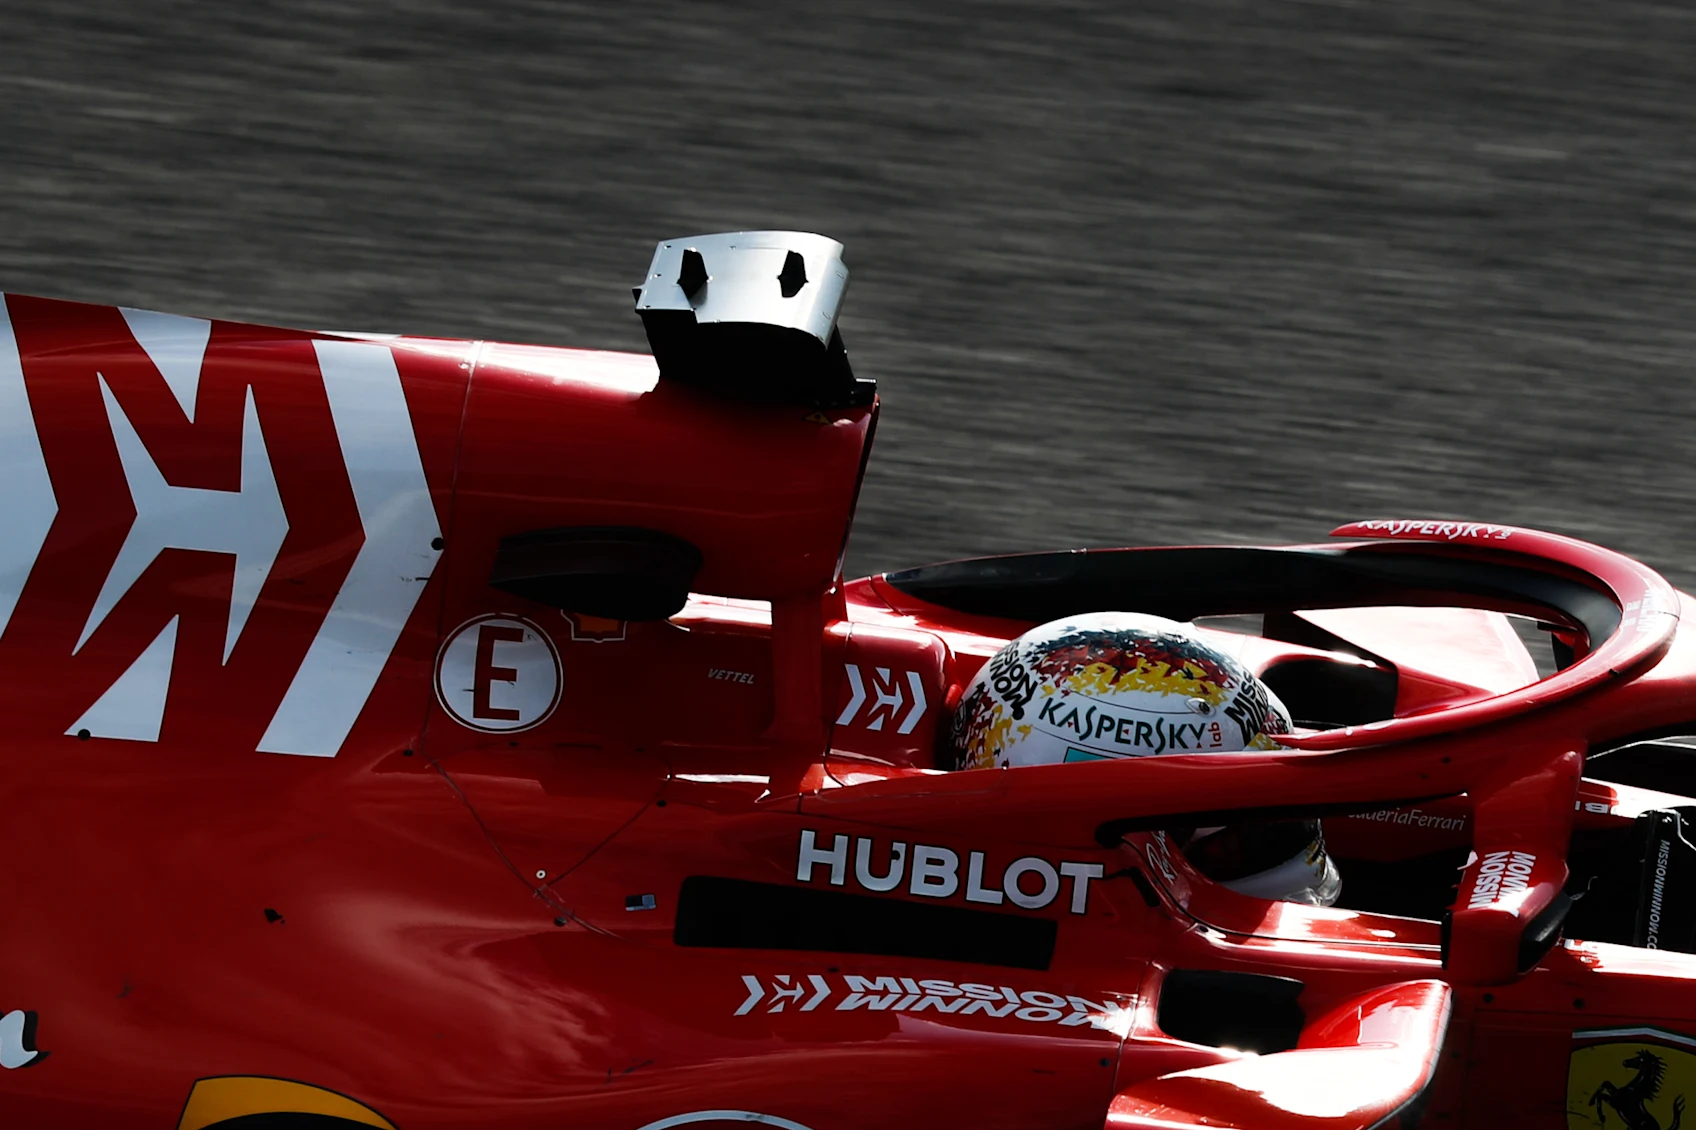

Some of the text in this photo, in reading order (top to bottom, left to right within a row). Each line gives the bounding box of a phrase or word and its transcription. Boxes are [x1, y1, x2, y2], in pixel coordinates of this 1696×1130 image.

[472, 624, 525, 720] E
[707, 667, 755, 685] VETTEL
[1039, 697, 1222, 755] KASPERSKY lab
[797, 830, 1105, 915] HUBLOT
[1468, 850, 1511, 910] MISSION
[1647, 839, 1671, 949] MISSIONWINNOW.CO
[841, 974, 1124, 1013] MISSION
